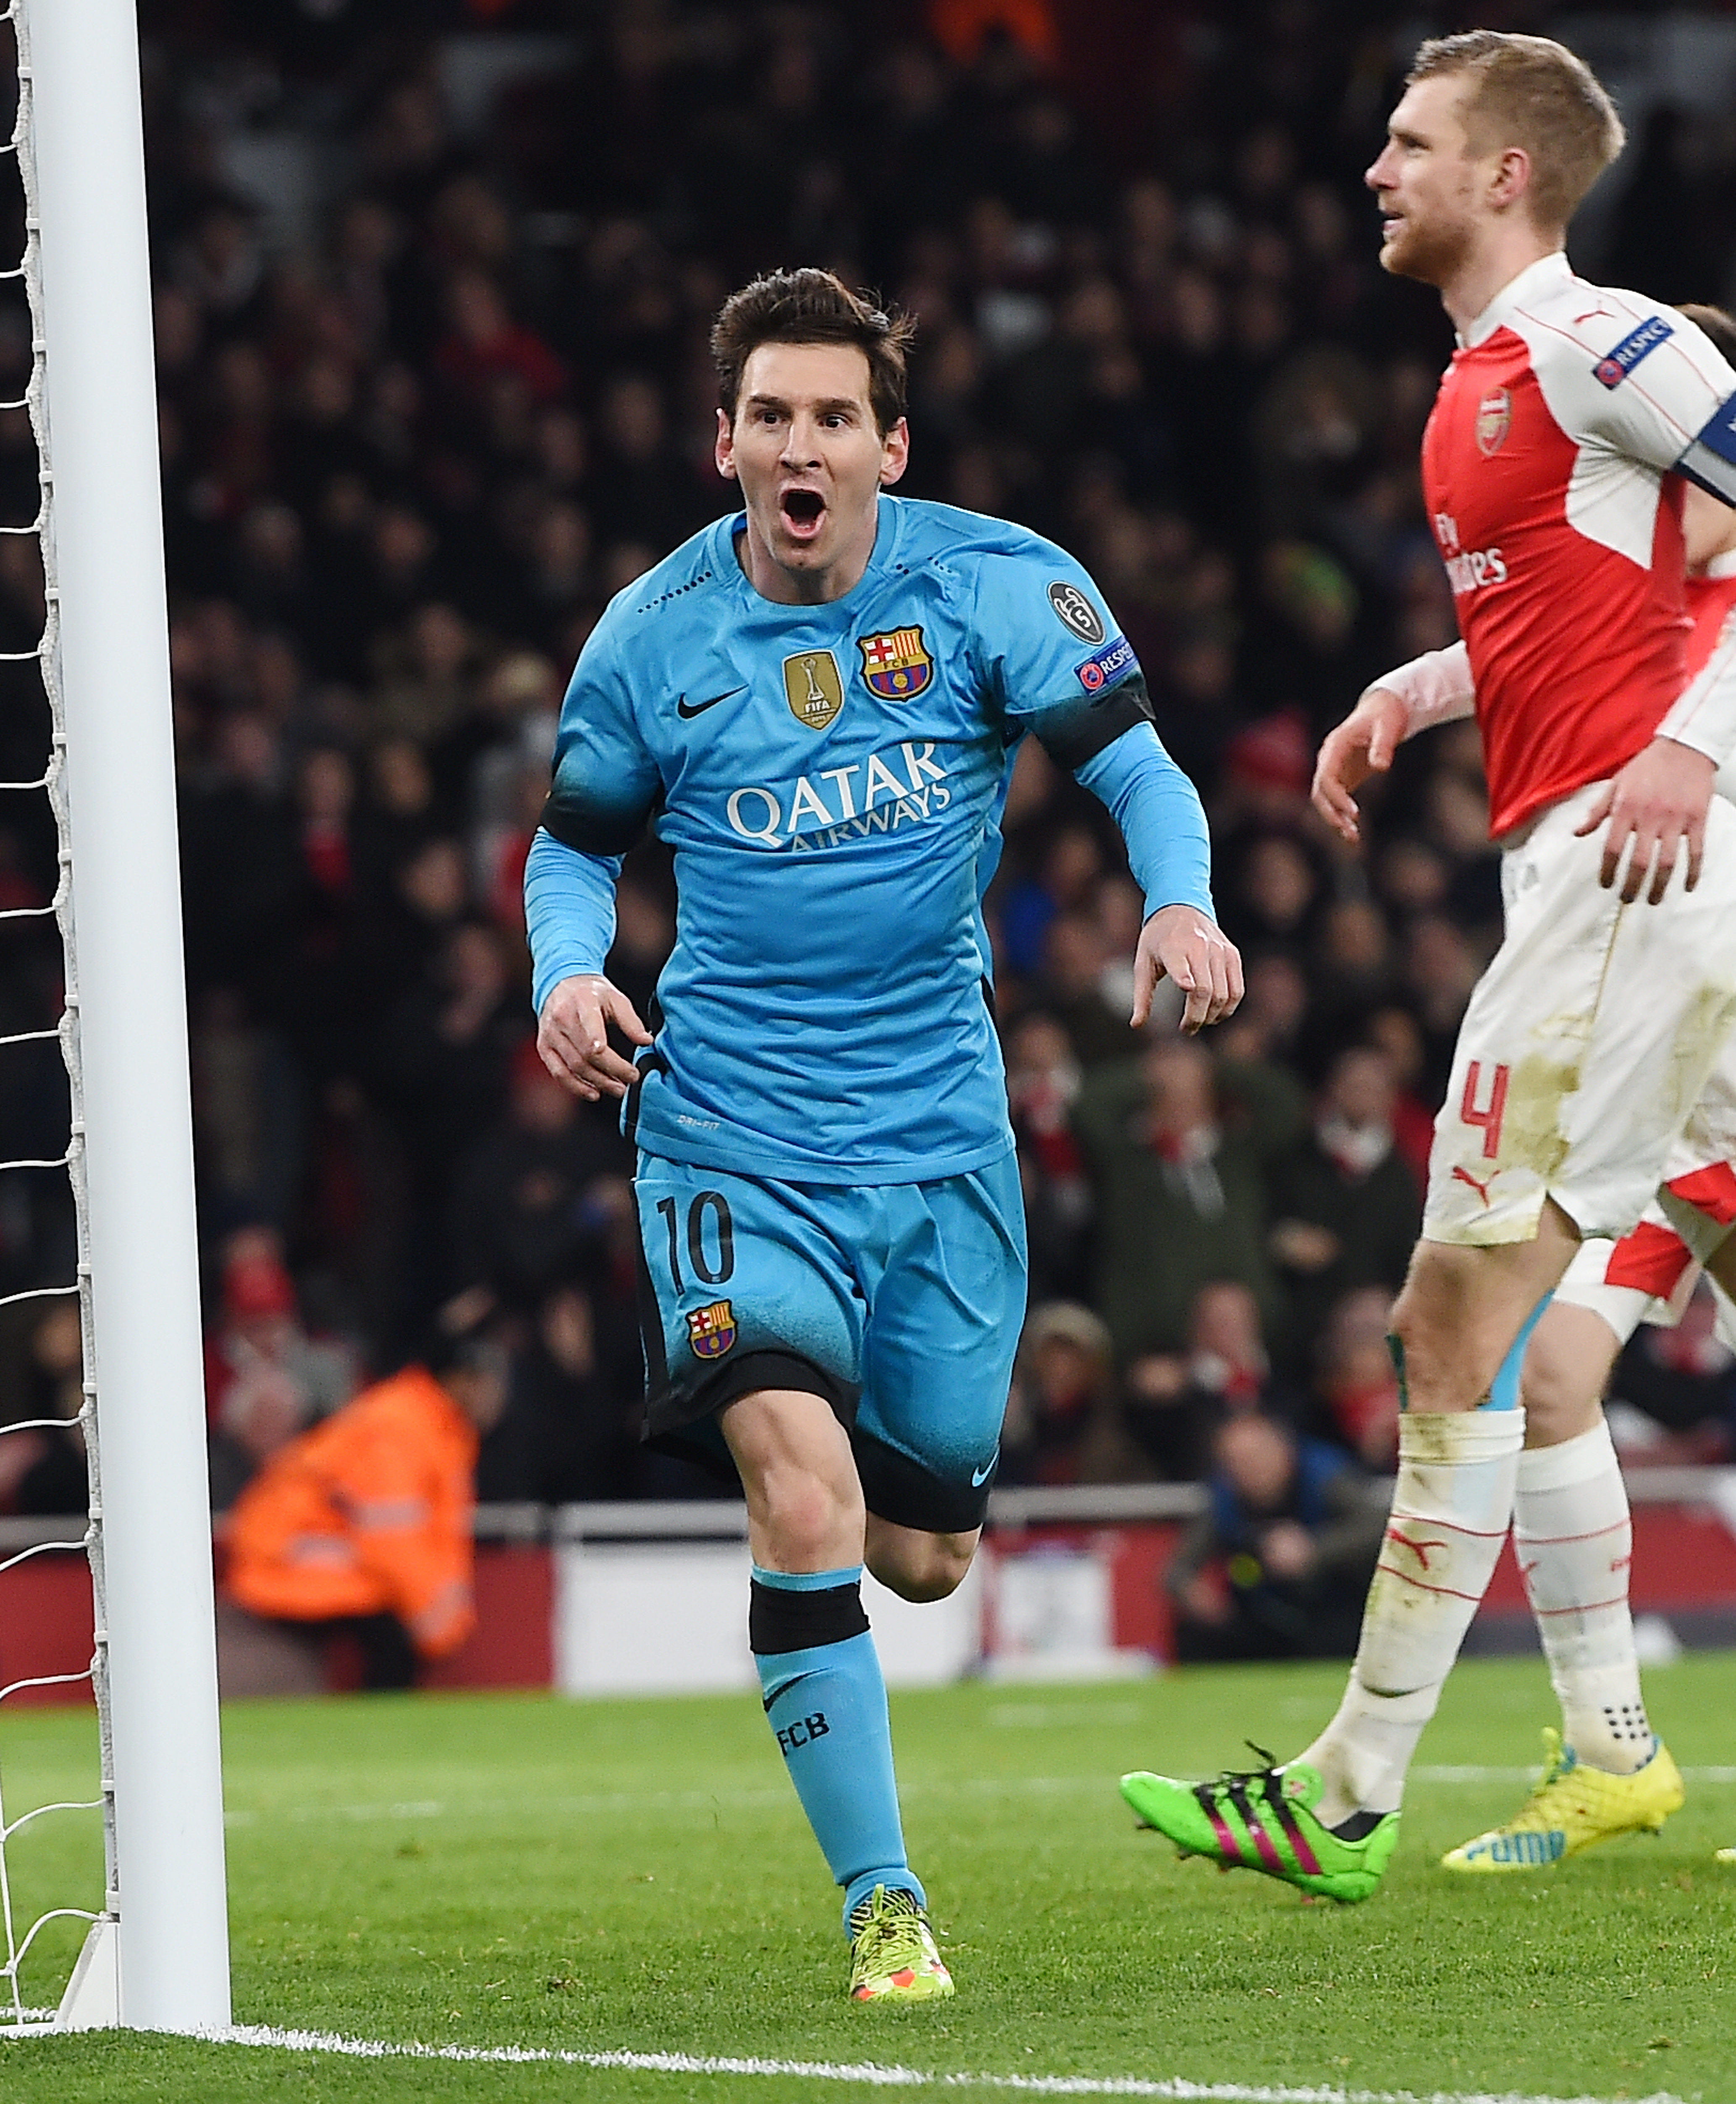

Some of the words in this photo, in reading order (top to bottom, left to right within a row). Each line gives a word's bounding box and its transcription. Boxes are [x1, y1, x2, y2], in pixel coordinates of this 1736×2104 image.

[1075, 609, 1091, 628] 5
[1100, 641, 1134, 675] RESPE
[805, 700, 830, 713] FIFA
[727, 742, 948, 848] QATAR
[792, 782, 951, 853] AIRWAYS
[677, 1115, 720, 1130] DRI-FIT
[1461, 1061, 1509, 1158] 4
[657, 1191, 735, 1296] 10
[776, 1712, 830, 1757] FCB
